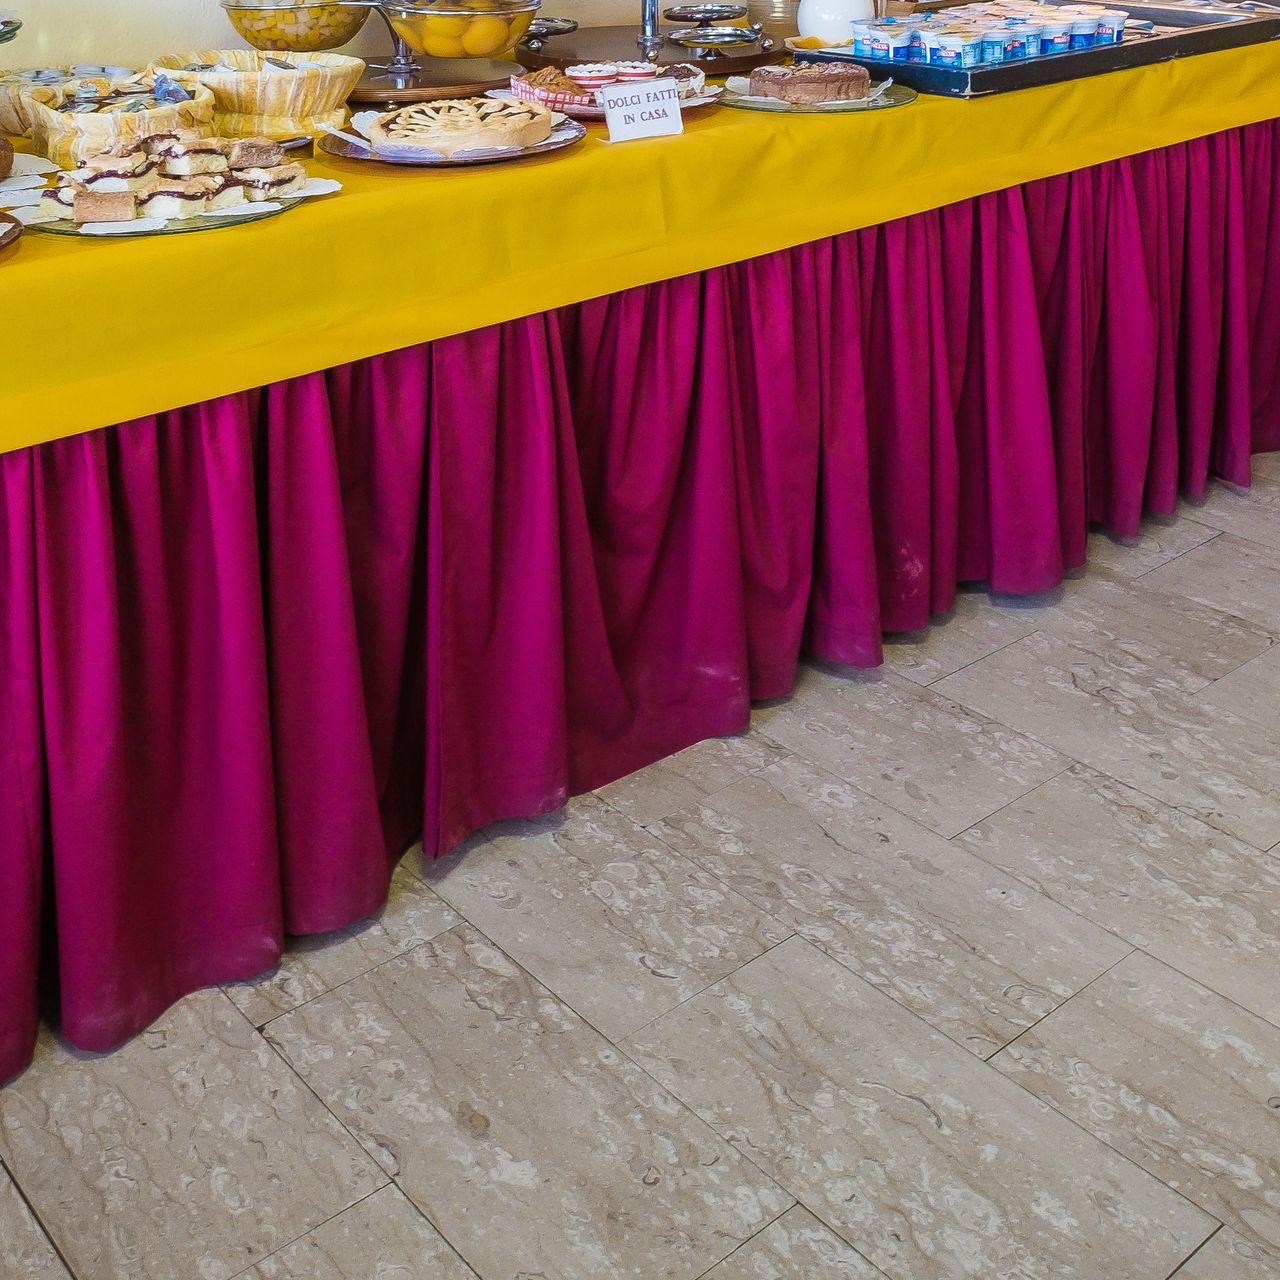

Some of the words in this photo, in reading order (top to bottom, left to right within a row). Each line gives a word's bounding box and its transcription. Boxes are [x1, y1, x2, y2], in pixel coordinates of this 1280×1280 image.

[607, 94, 641, 110] DOLCI
[646, 88, 677, 103] FATTI
[623, 113, 636, 125] IN
[640, 108, 669, 122] CASA
